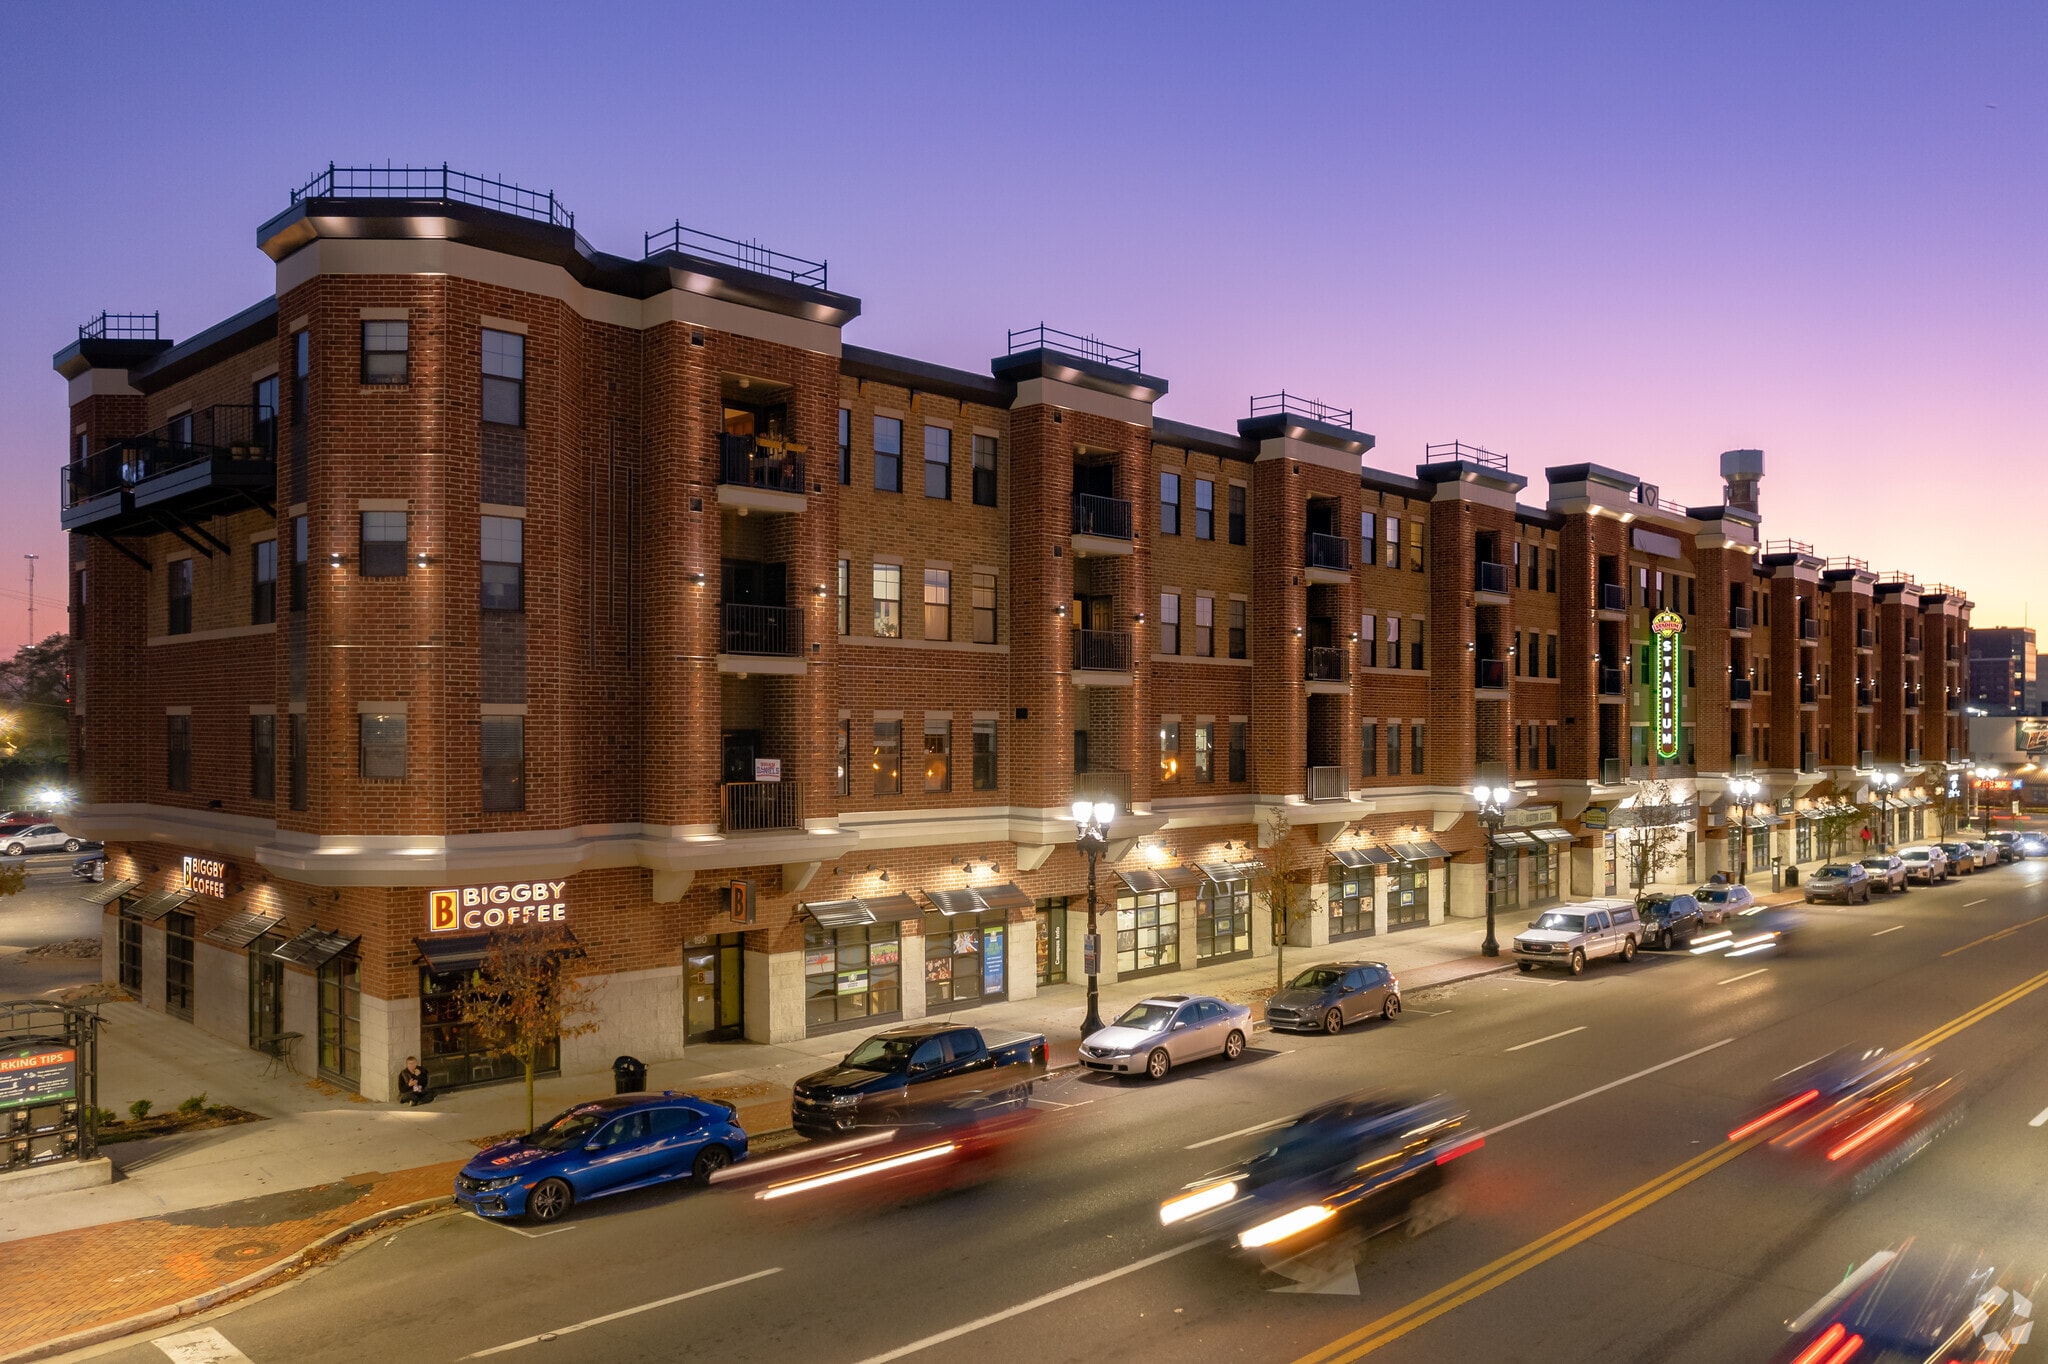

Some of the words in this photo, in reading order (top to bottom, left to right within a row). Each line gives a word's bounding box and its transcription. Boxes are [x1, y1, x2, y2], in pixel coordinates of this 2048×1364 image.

[1662, 640, 1672, 744] STADIUM
[192, 858, 225, 878] BIGGBY
[192, 876, 225, 899] COFFEE
[463, 881, 566, 907] BIGGBY
[435, 895, 454, 928] B
[734, 887, 744, 917] B
[463, 903, 566, 929] COFFEE
[0, 1057, 37, 1071] RKING
[40, 1053, 64, 1064] TIPS
